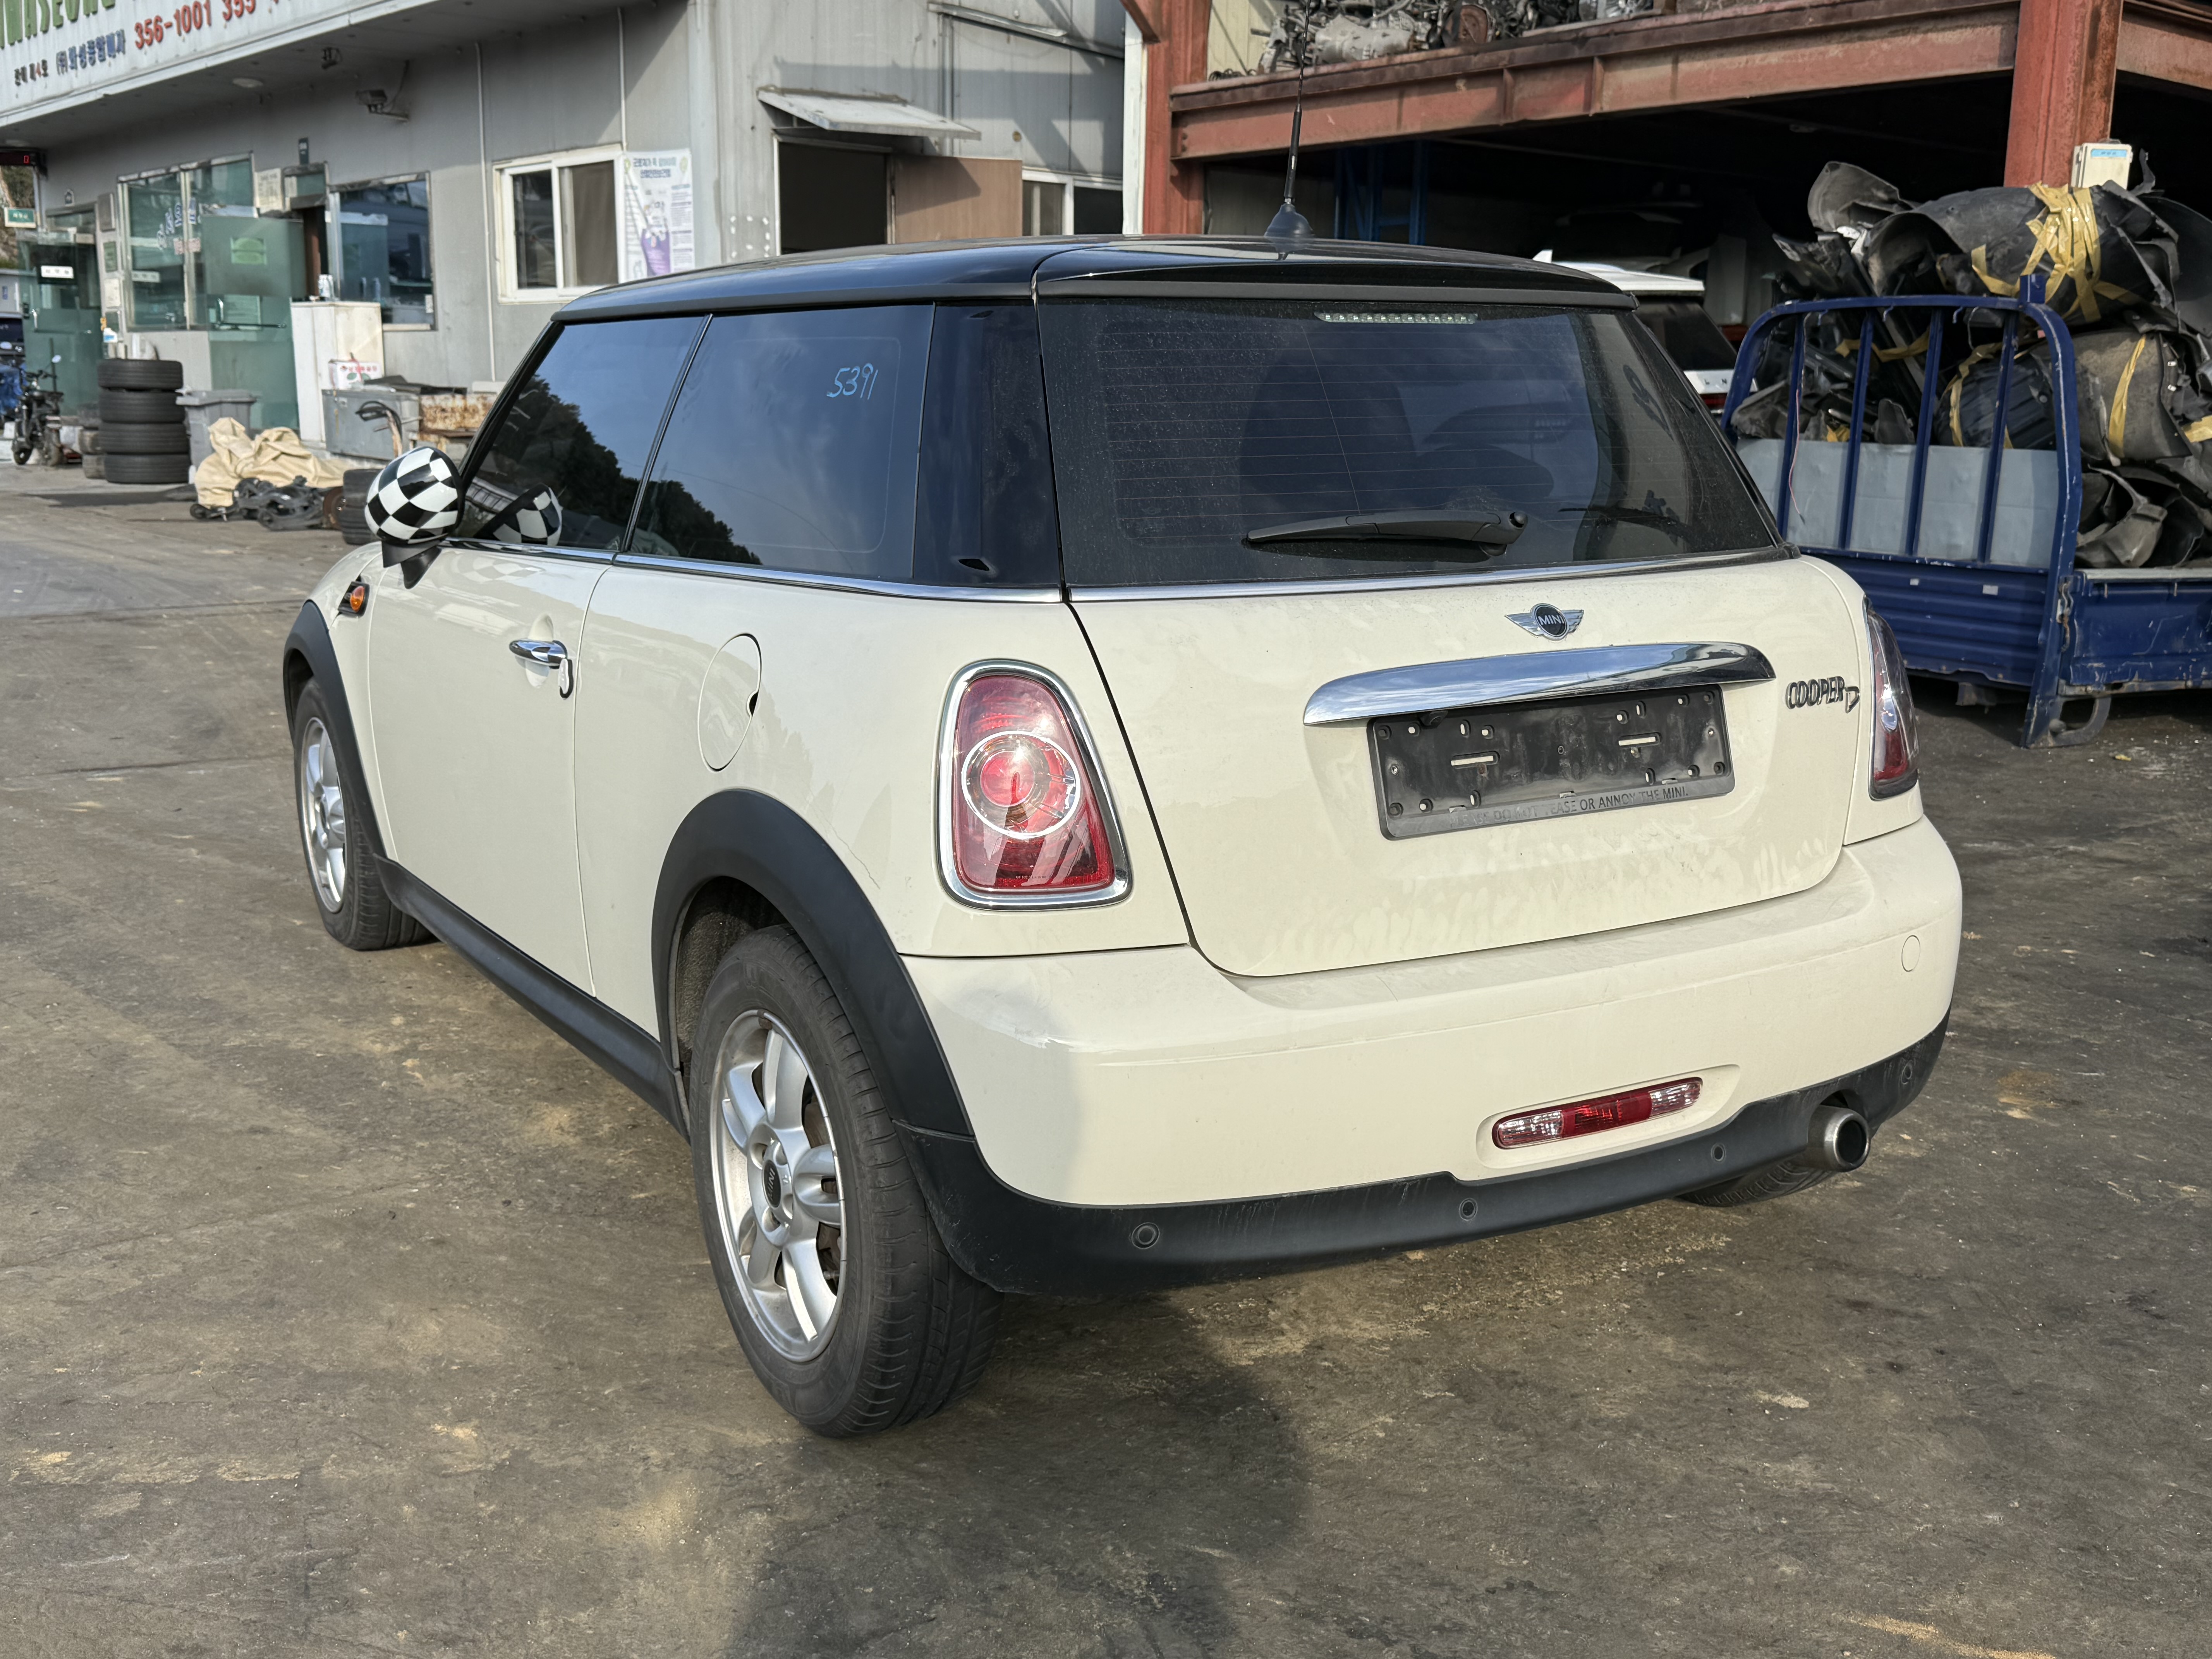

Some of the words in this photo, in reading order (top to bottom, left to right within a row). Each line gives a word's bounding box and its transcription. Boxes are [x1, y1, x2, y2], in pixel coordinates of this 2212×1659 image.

[134, 0, 211, 49] 356-1001
[826, 362, 878, 400] 5391
[1538, 615, 1564, 625] MINI
[1785, 676, 1845, 709] COOPER
[1844, 686, 1860, 714] D
[1580, 798, 1595, 811] OR
[1598, 792, 1636, 809] ANNOY
[1638, 789, 1661, 803] THE
[1662, 786, 1688, 800] MINI.
[767, 1167, 776, 1201] MINI
